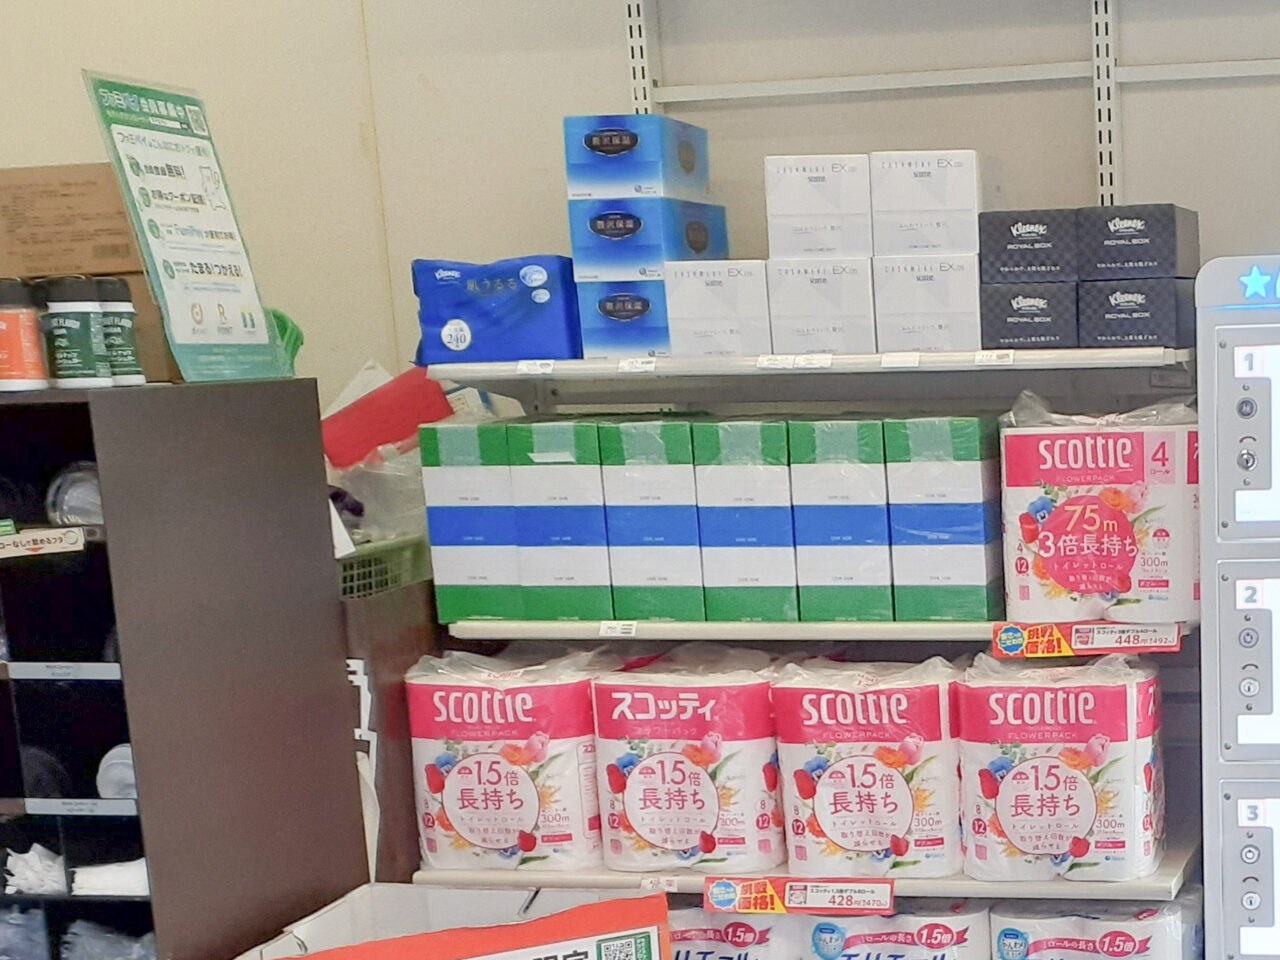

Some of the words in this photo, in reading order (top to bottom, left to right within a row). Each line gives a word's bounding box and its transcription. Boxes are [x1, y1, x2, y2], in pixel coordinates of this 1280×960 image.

[1010, 221, 1048, 237] Kleenex
[1107, 217, 1145, 233] Kleenex
[1010, 295, 1048, 310] Kleenex
[1108, 291, 1146, 306] Kleenex
[1243, 352, 1255, 371] 1
[1038, 437, 1134, 471] scottie
[1151, 440, 1169, 467] 4
[1038, 531, 1139, 558] 3倍長持ち
[1244, 586, 1258, 604] 2
[433, 691, 537, 724] scottie
[611, 691, 717, 721] スコッティ
[802, 692, 908, 725] scottie
[988, 690, 1097, 725] scottie
[473, 761, 520, 787] 1.5倍
[656, 761, 702, 787] 1.5倍
[846, 763, 896, 790] 1.5倍
[1029, 763, 1079, 790] 1.5倍
[457, 788, 524, 810] 長持ち
[639, 788, 706, 810] 長持ち
[828, 790, 899, 815] 長持ち
[1010, 792, 1081, 818] 長持ち
[1247, 804, 1259, 821] 3
[1101, 936, 1135, 954] 1.5倍
